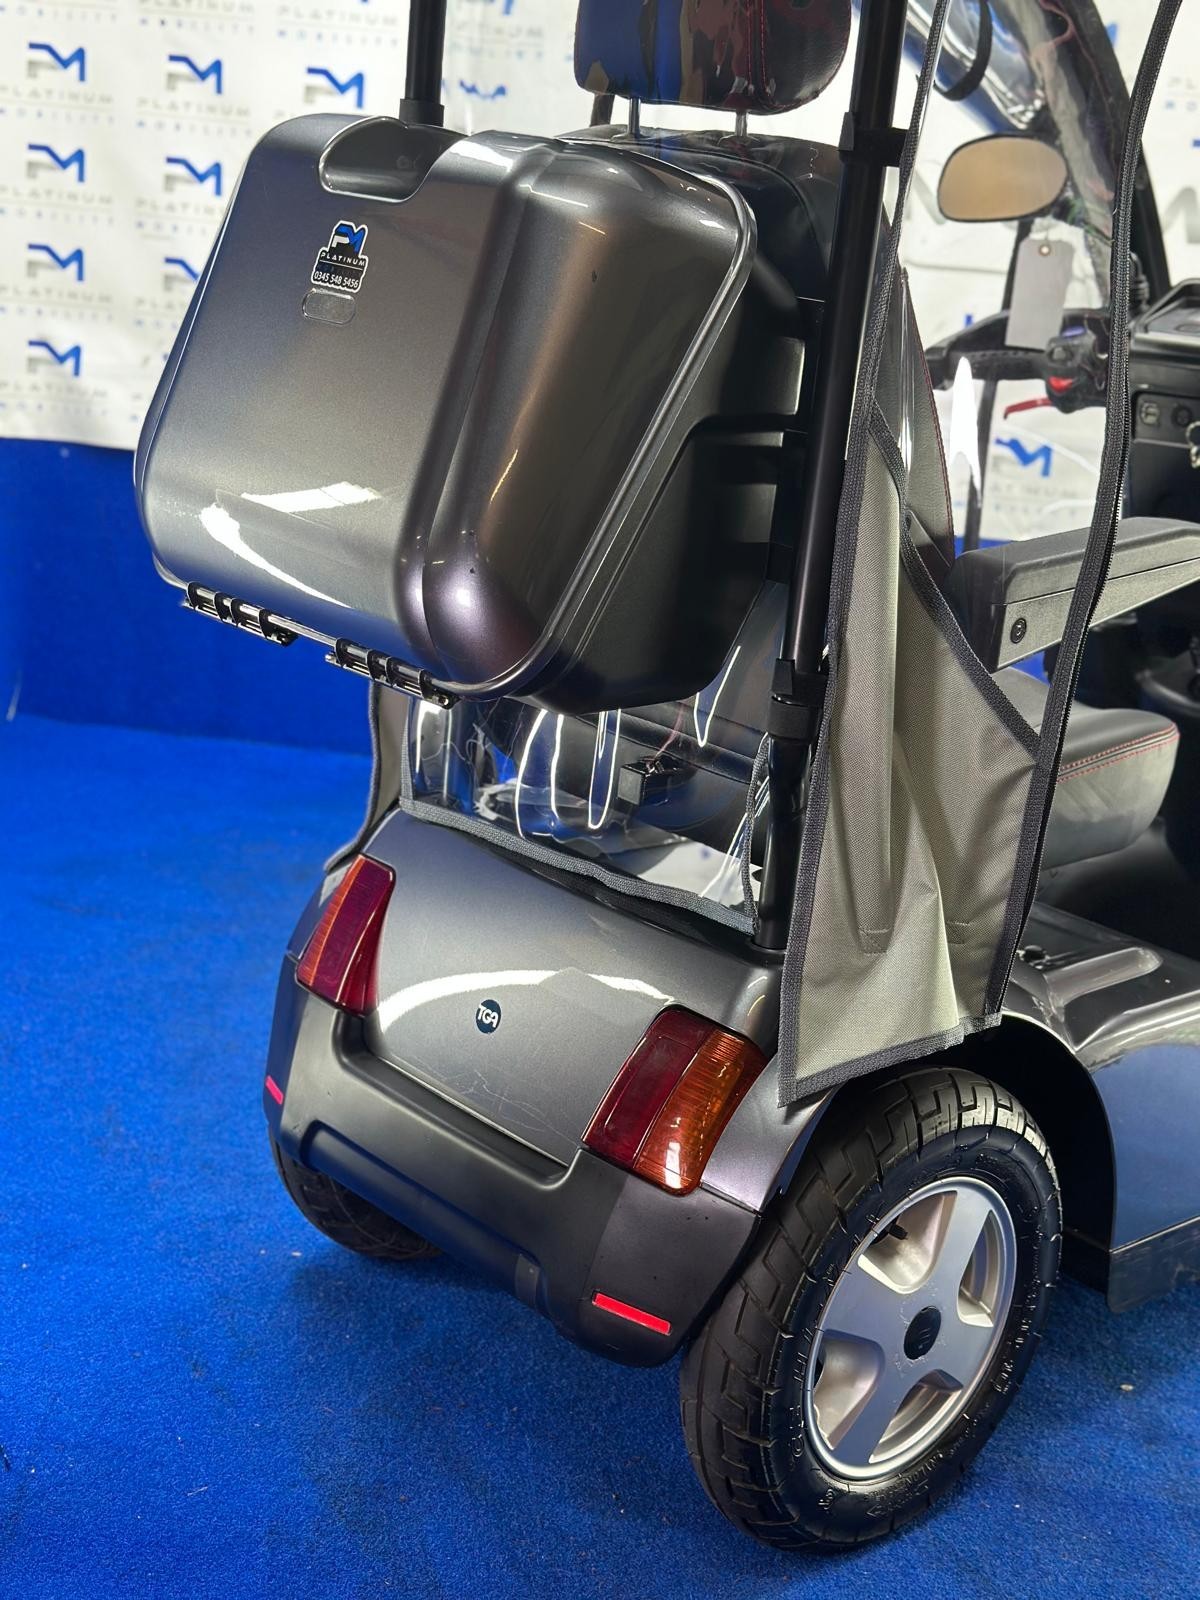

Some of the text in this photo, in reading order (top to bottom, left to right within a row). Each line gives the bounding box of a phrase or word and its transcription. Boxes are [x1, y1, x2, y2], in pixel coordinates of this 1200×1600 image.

[320, 251, 366, 266] PLATINUM
[314, 271, 360, 289] 0345 548 5456
[478, 1004, 499, 1028] TGA
